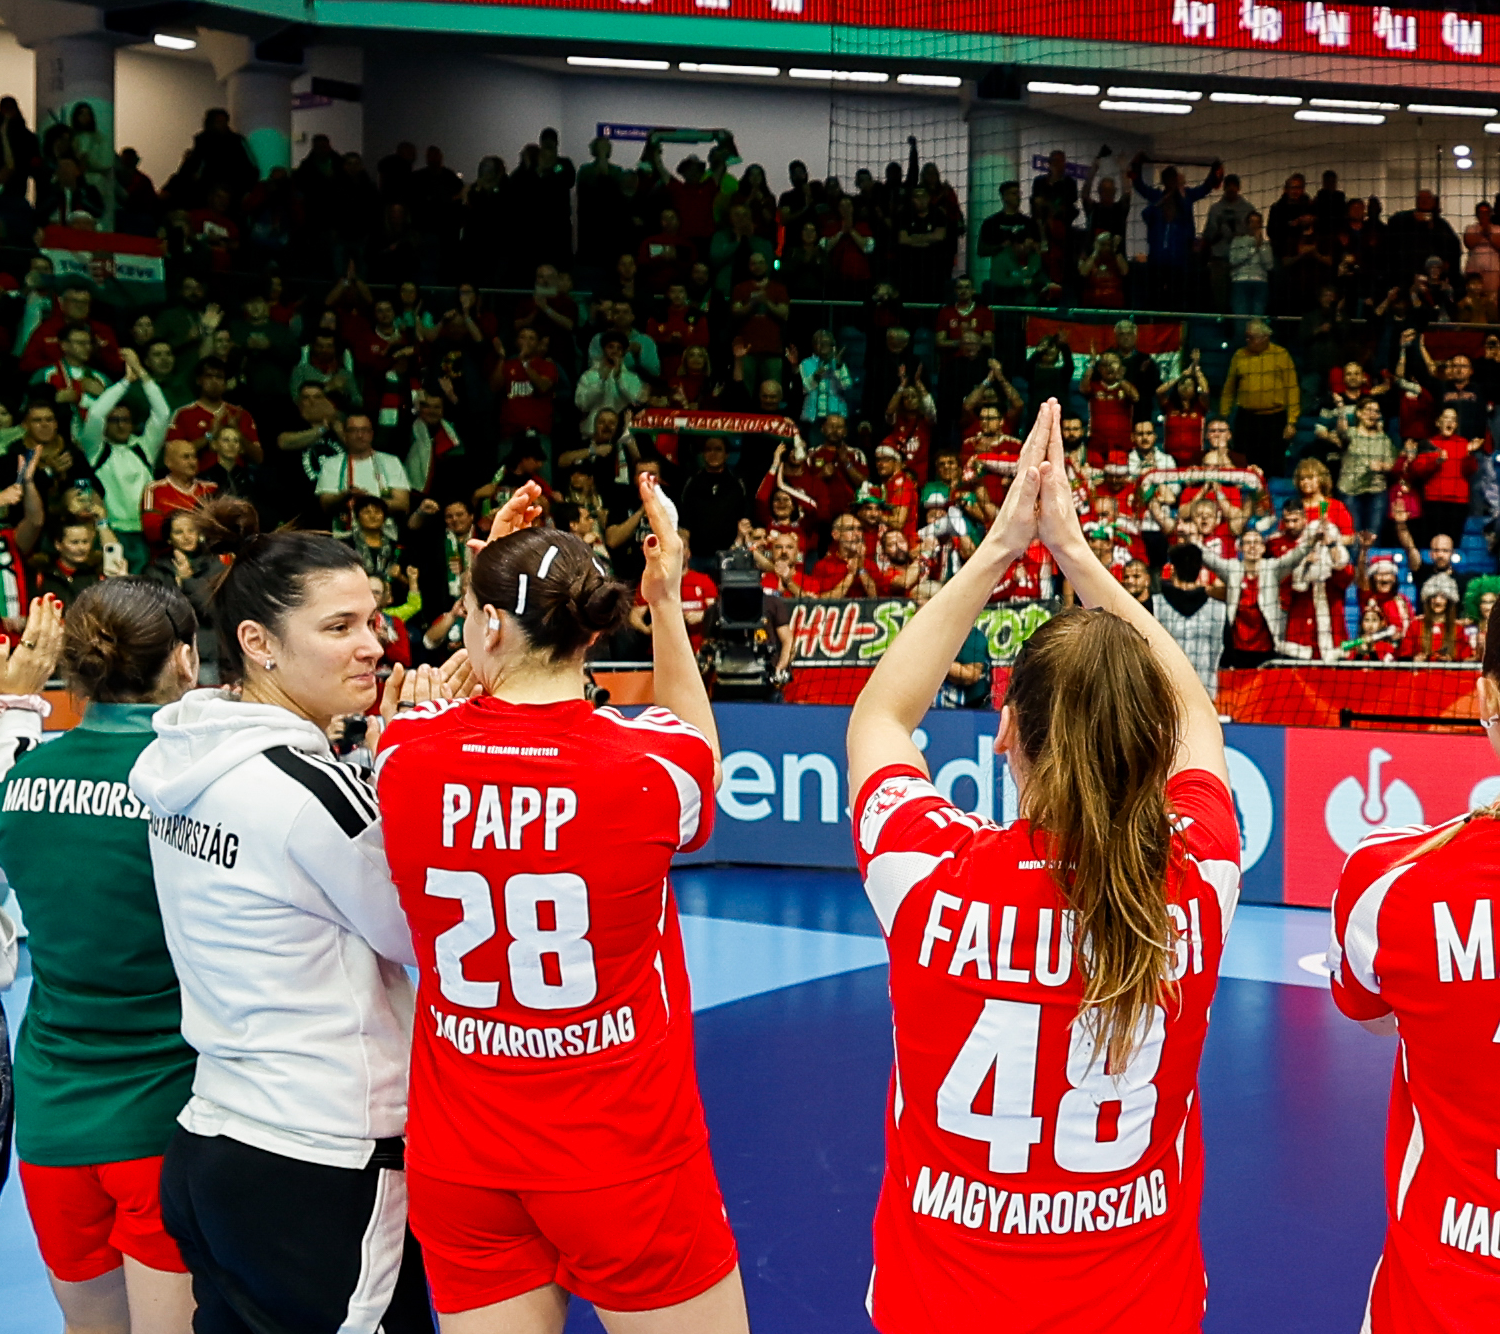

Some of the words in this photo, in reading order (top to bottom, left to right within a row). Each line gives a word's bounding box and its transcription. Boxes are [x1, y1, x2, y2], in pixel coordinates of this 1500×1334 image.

[442, 783, 578, 853] PAPP
[424, 868, 598, 1011] 28
[430, 1004, 636, 1060] MAGYARORSZÁG
[936, 998, 1169, 1174] 48
